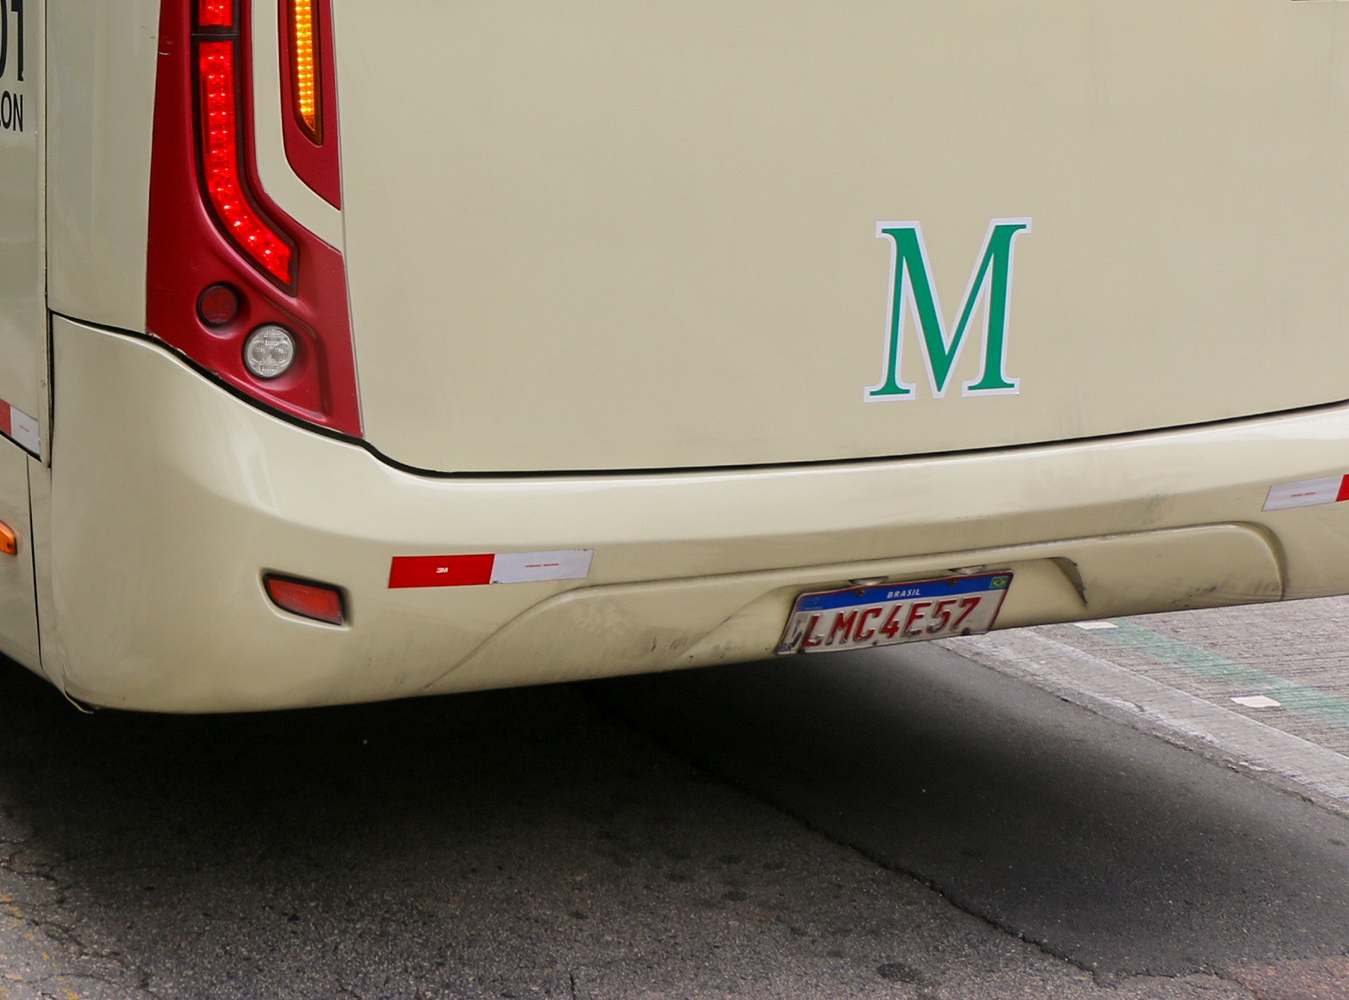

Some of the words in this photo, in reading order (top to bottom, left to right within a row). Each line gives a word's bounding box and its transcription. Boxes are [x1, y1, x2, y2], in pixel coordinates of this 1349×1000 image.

[863, 217, 1032, 403] M
[886, 588, 921, 599] BRASIL
[801, 595, 982, 647] LMC4E57
